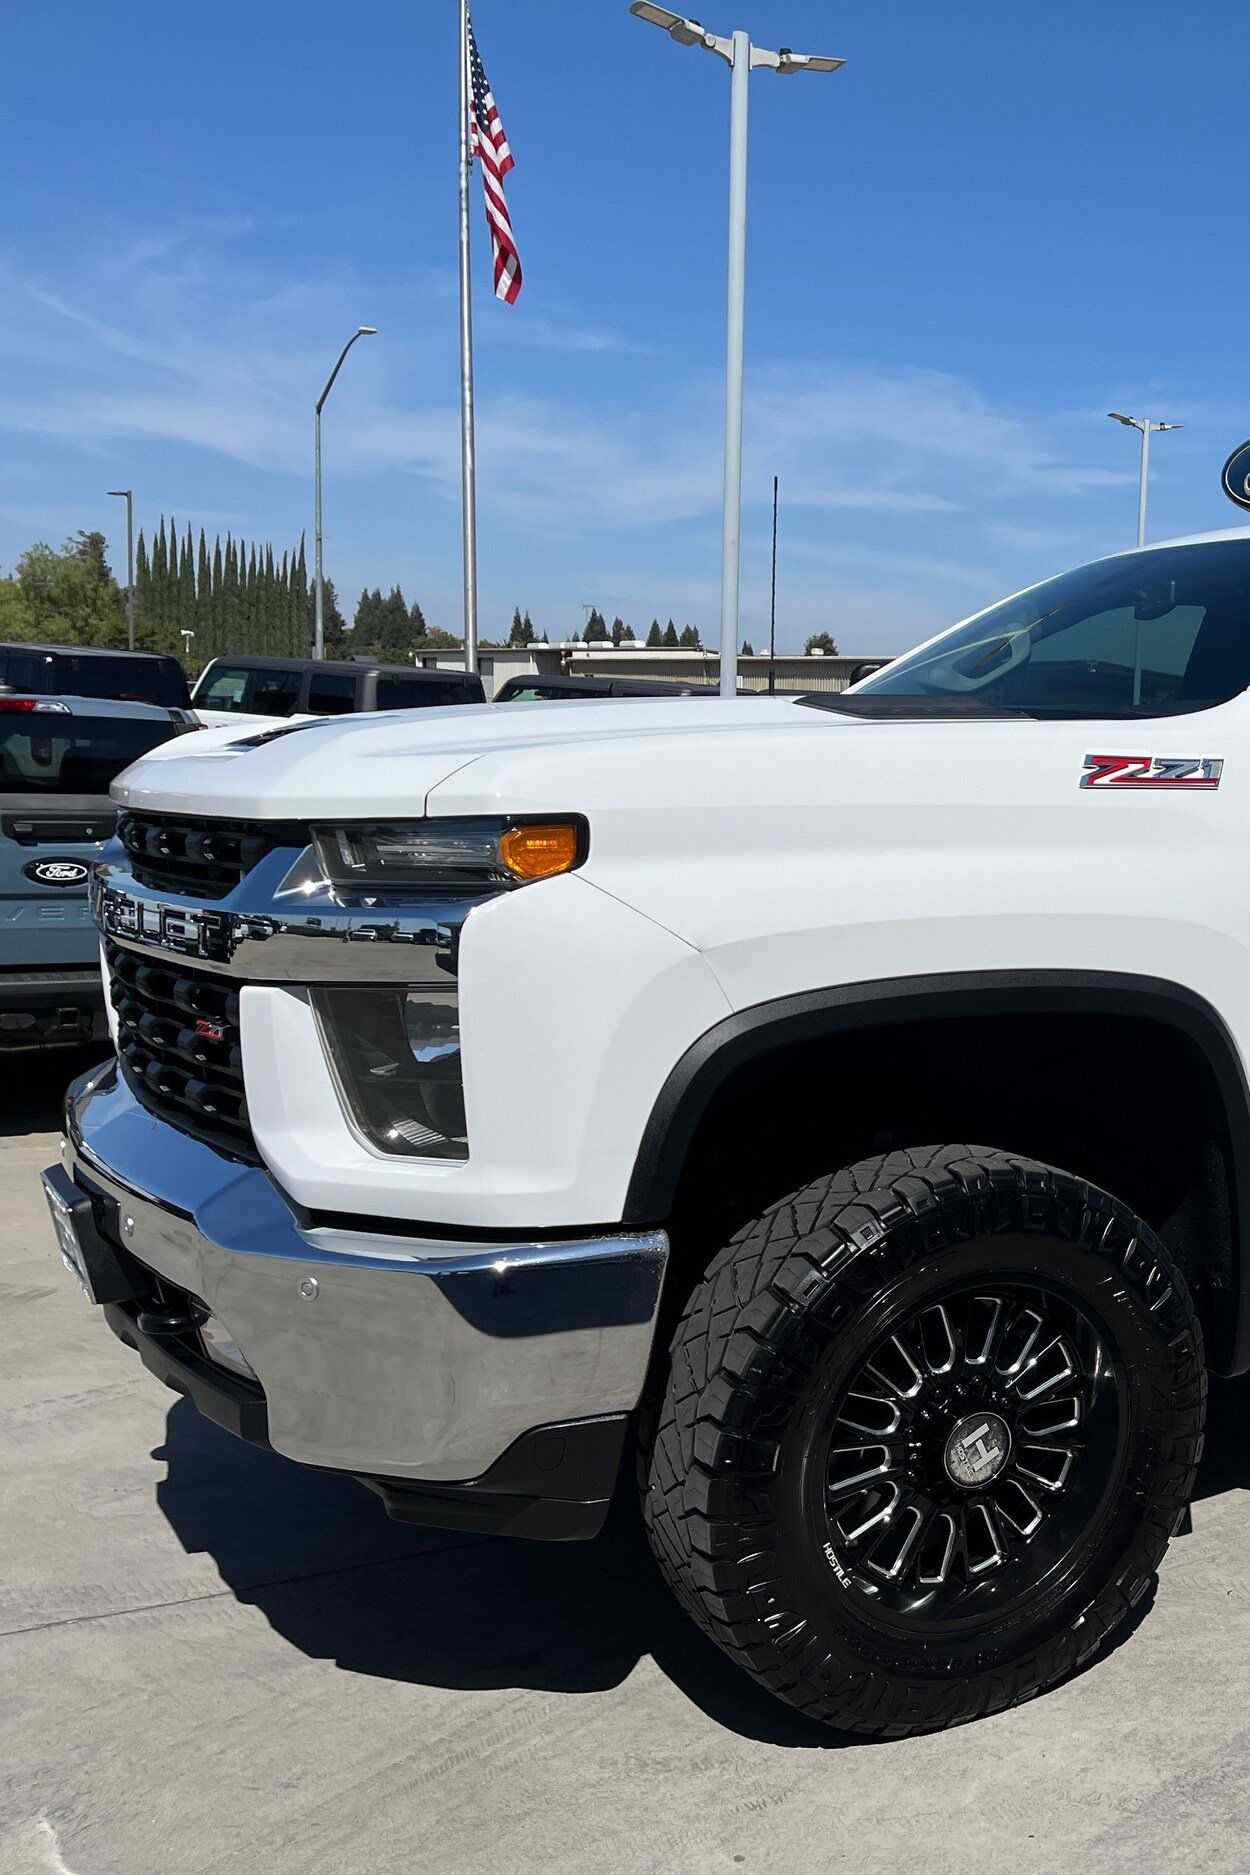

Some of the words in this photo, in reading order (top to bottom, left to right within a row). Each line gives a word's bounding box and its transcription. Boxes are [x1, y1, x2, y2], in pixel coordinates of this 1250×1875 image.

[1079, 754, 1224, 790] Z71
[46, 865, 77, 877] Ford
[955, 1442, 975, 1477] HOSTILE
[822, 1541, 852, 1589] HOSTILE
